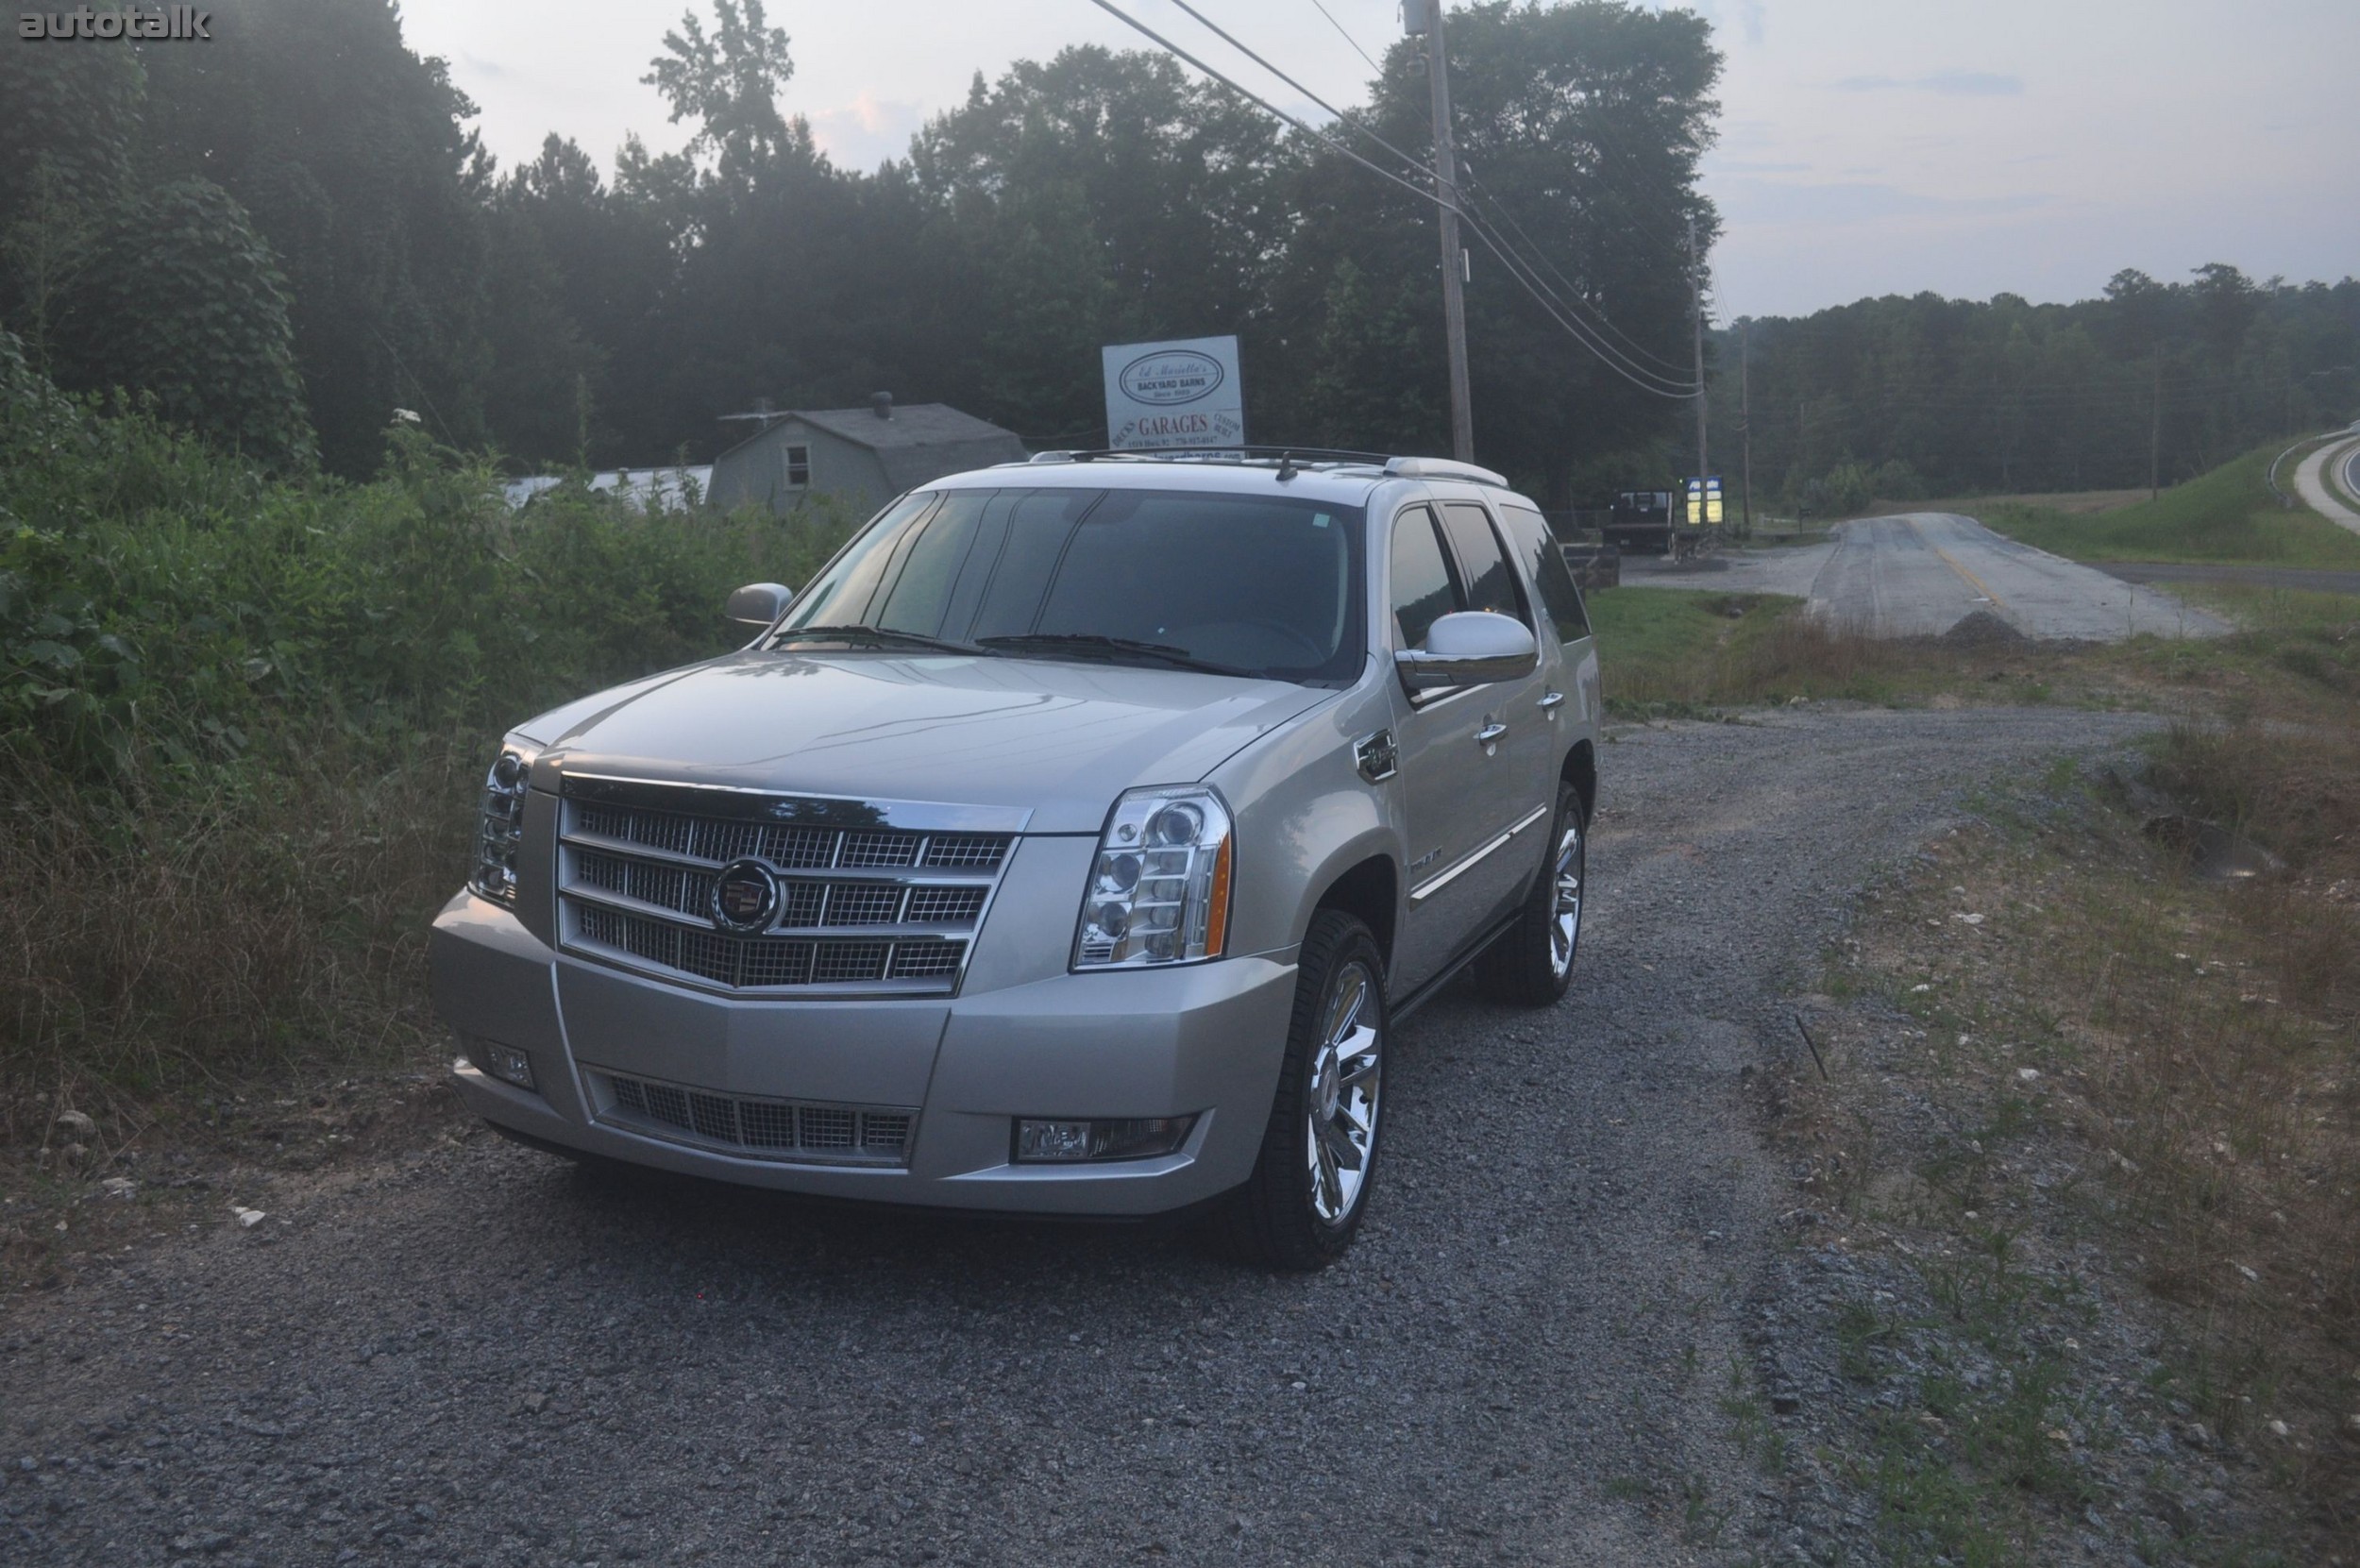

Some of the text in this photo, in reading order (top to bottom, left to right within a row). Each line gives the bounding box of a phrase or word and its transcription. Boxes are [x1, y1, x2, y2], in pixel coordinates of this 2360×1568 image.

[1138, 378, 1205, 391] BACKYARD BARNS
[1138, 413, 1208, 436] GARAGES
[1213, 413, 1240, 432] CUSTOM
[1112, 420, 1137, 447] DECKS
